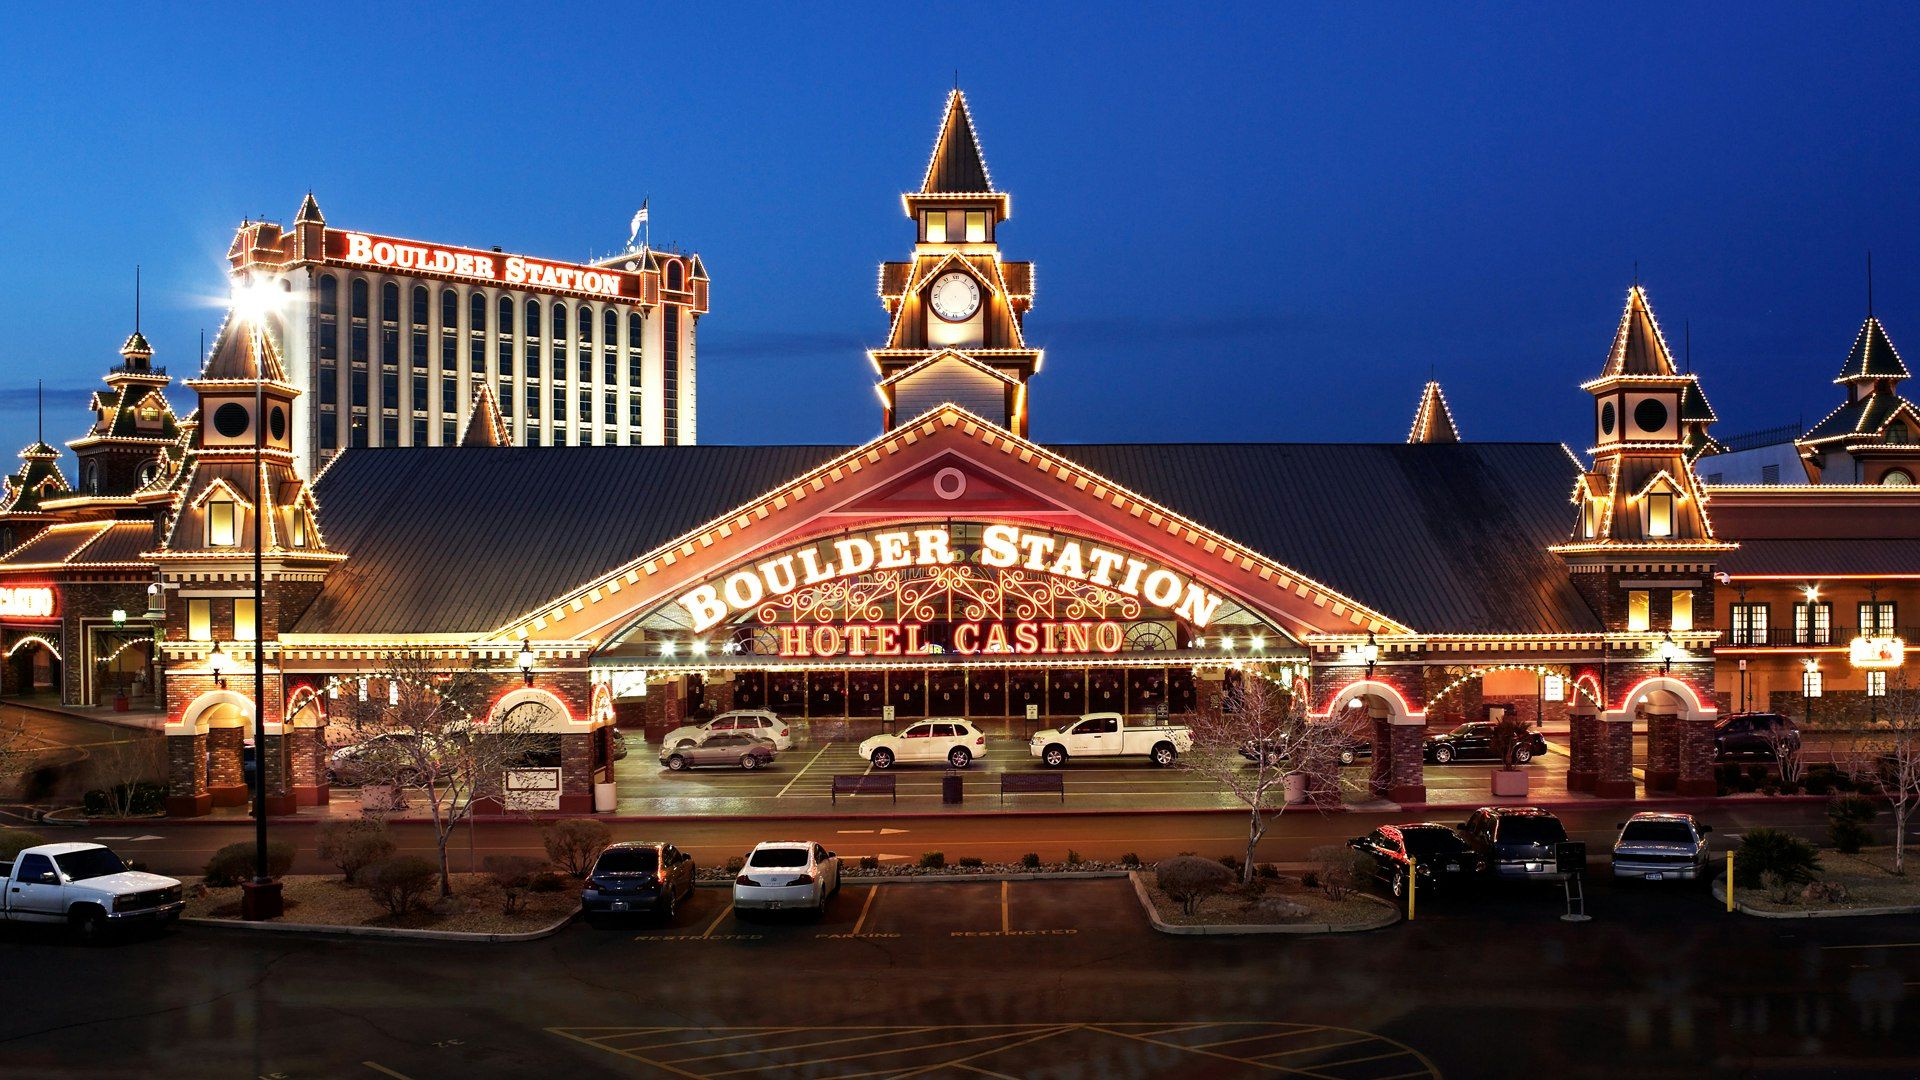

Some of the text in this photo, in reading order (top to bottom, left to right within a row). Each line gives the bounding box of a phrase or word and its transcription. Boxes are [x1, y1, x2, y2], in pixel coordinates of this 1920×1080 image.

[345, 233, 621, 296] BOULDER STATION
[678, 525, 1223, 633] BOULDER STATION
[779, 621, 1125, 657] HOTEL CASINO
